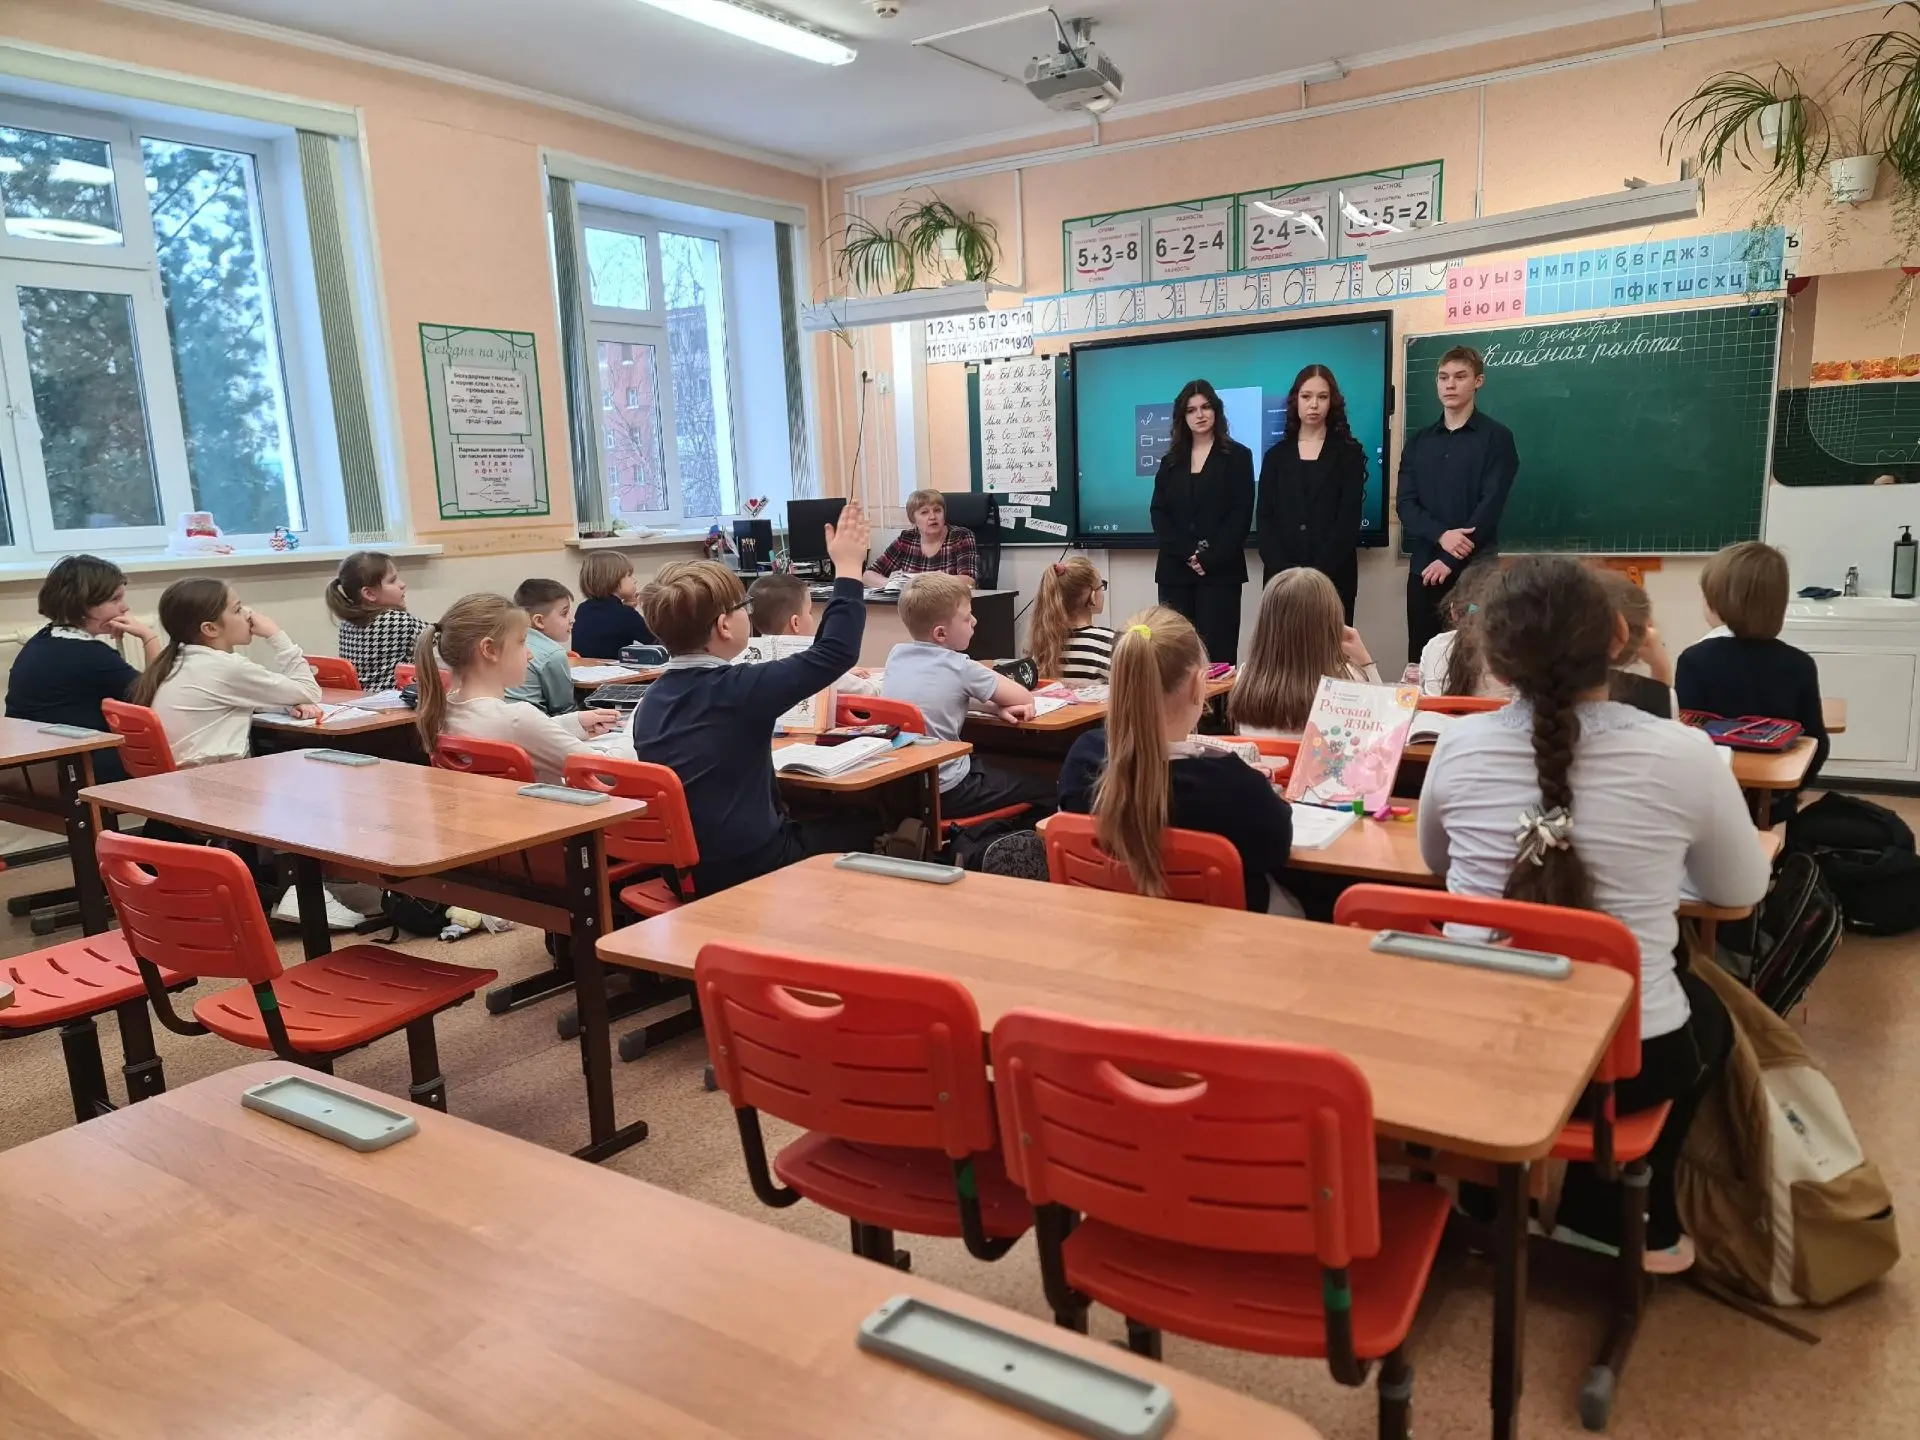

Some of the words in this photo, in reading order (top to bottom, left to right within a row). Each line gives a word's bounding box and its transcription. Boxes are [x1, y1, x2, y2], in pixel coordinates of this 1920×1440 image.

[1118, 288, 1135, 325] 2
[1157, 284, 1175, 320] 3
[1200, 278, 1215, 315] 4
[1217, 298, 1225, 311] 5
[1239, 274, 1258, 311] 5
[1261, 293, 1270, 307] 6
[1283, 268, 1304, 306] 6
[1306, 288, 1315, 301] 7
[1329, 262, 1348, 302] 7
[1353, 284, 1361, 297] 8
[1400, 277, 1409, 291] 9
[1628, 282, 1643, 301] ф
[1730, 274, 1742, 288] ц
[927, 322, 934, 335] 1
[937, 321, 945, 335] 2
[968, 318, 976, 331] 5
[978, 316, 986, 329] 6
[988, 315, 996, 328] 7
[1021, 311, 1032, 323] 10
[926, 344, 936, 358] 11
[957, 341, 967, 355] 14
[989, 339, 999, 351] 17
[1011, 337, 1021, 350] 19
[1022, 335, 1033, 349] 20
[1518, 329, 1535, 345] 10
[426, 341, 474, 359] Сегодня
[480, 348, 493, 358] на
[497, 348, 529, 363] уроке
[1483, 344, 1588, 367] Классная
[1320, 698, 1371, 718] Русский
